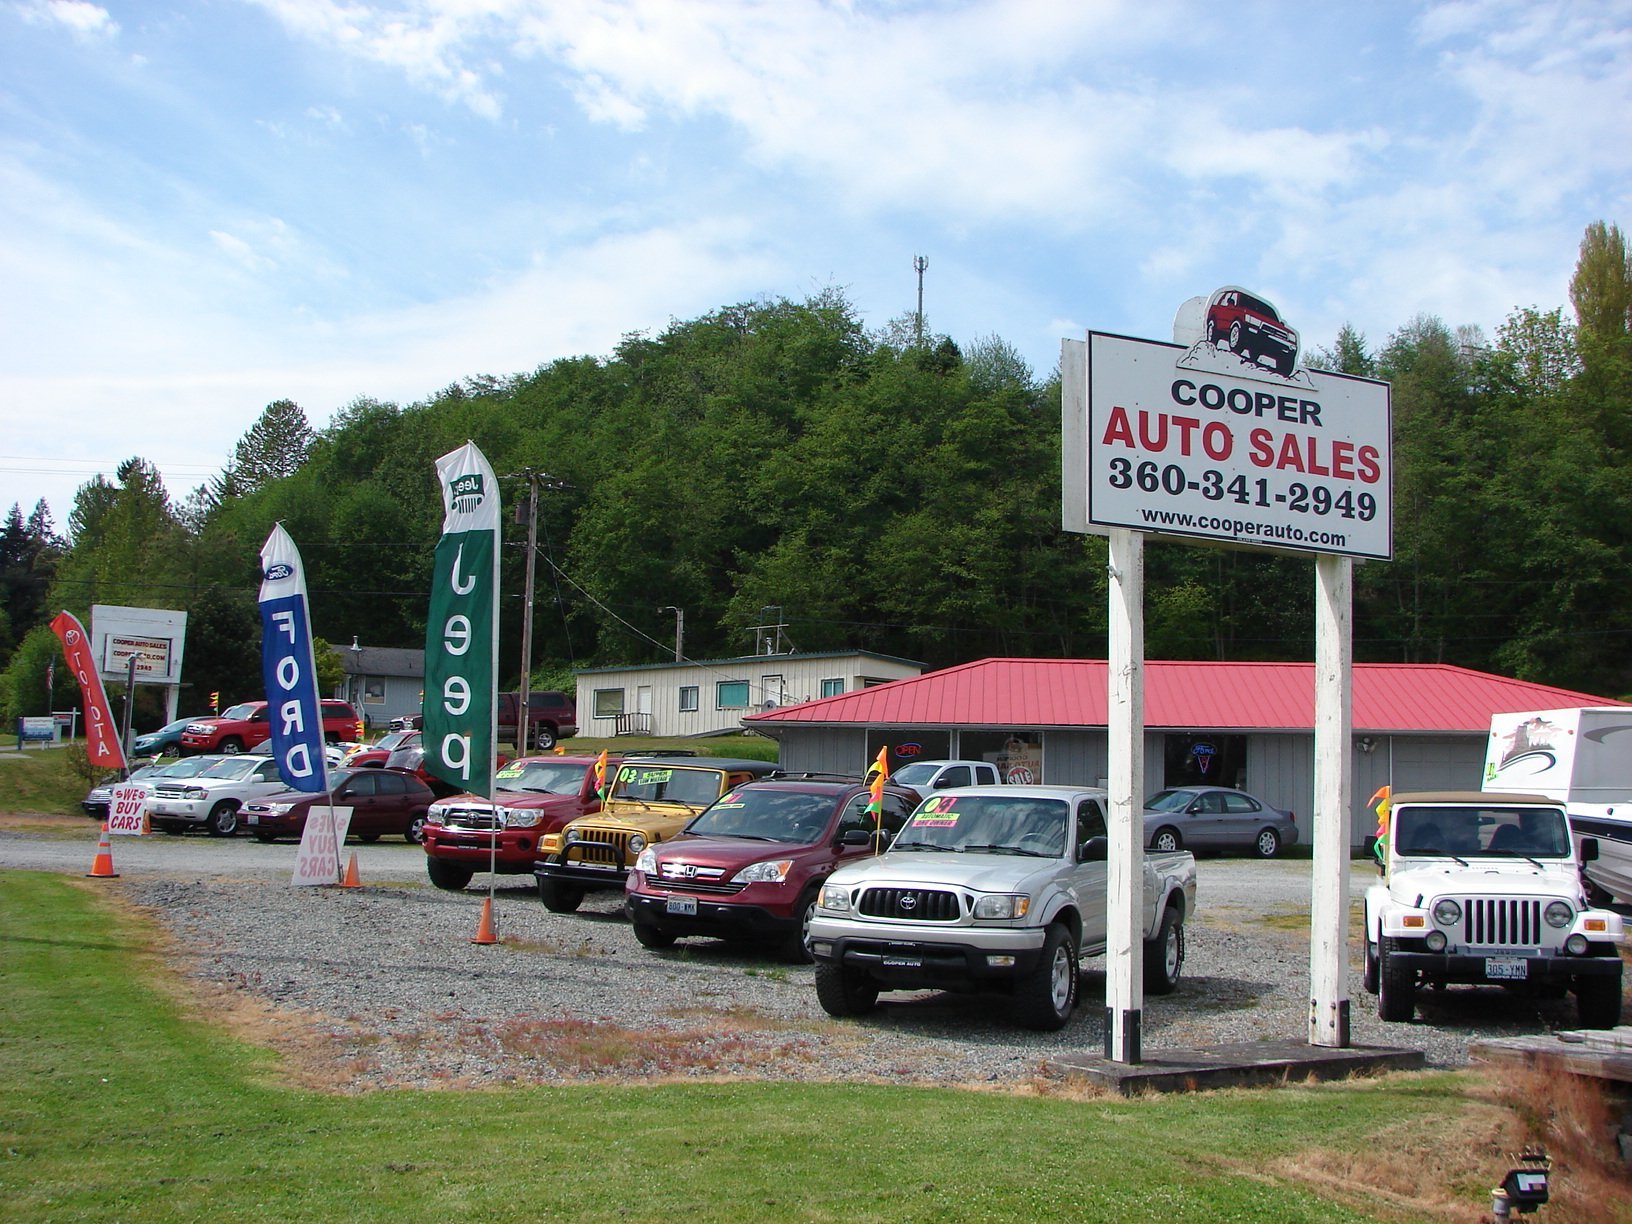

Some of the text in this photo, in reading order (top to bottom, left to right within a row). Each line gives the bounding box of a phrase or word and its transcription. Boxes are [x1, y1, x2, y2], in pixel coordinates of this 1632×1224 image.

[1171, 379, 1322, 427] COOPER
[1102, 406, 1381, 484] AUTO SALES
[1108, 457, 1377, 522] 360-341-2949
[1141, 508, 1346, 547] www.cooperauto.com
[113, 638, 134, 647] COOPER
[149, 642, 167, 650] SALES
[73, 651, 110, 757] TOYOTA
[895, 745, 922, 755] OPEN
[620, 767, 638, 784] 03
[1009, 771, 1032, 785] SALE
[116, 802, 142, 815] BUY
[111, 815, 142, 831] CARS
[1487, 963, 1526, 976] 305-YMN
